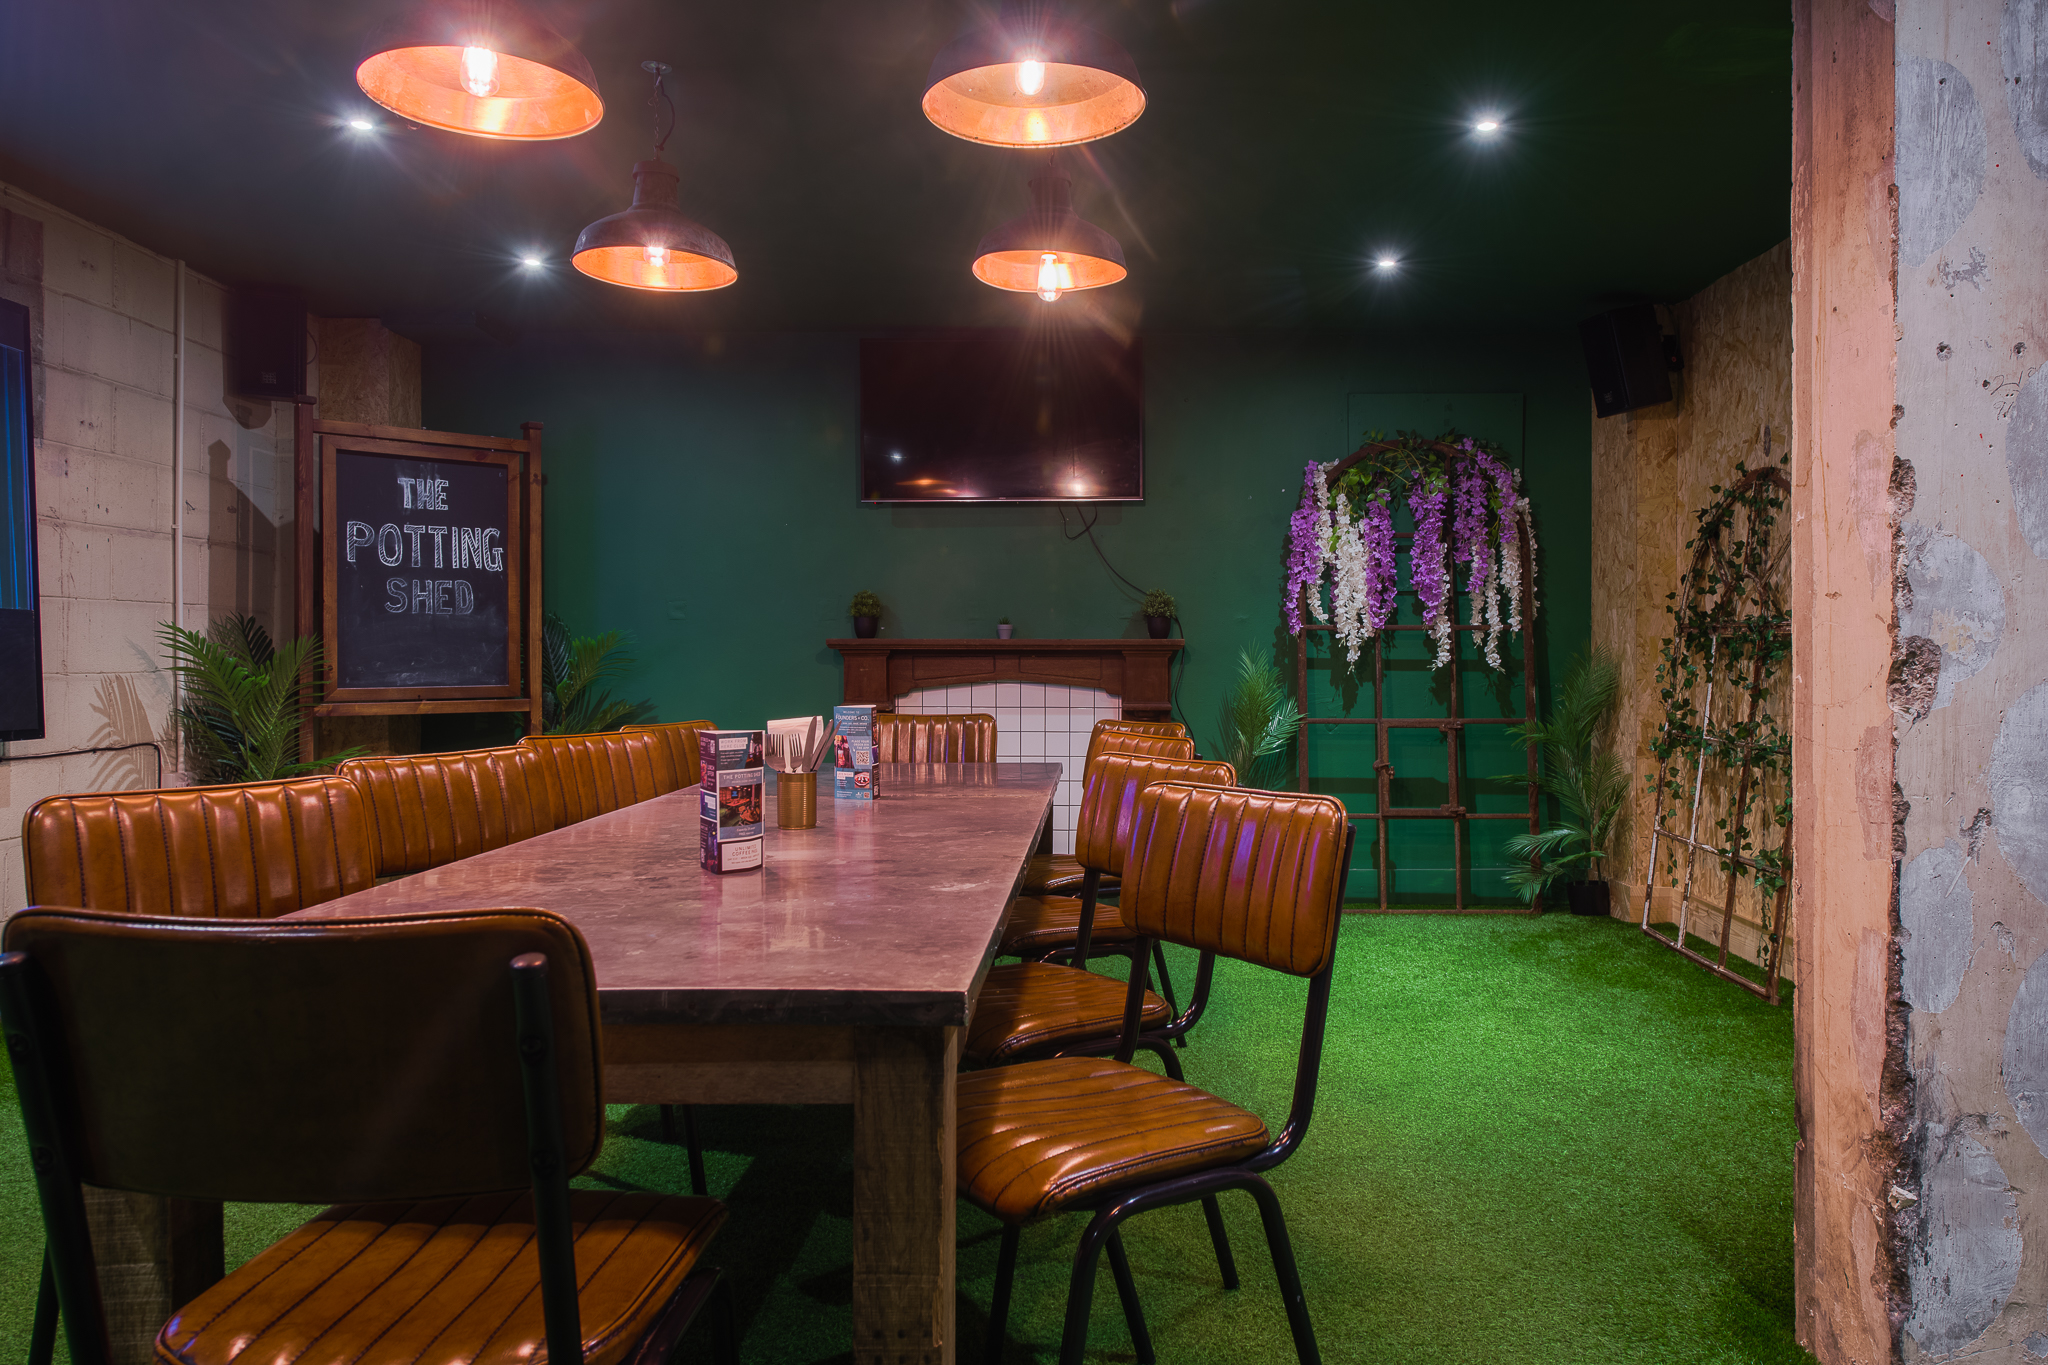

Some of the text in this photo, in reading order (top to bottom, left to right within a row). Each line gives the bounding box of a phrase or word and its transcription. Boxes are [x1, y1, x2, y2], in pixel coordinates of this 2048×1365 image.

[397, 477, 449, 510] THE
[346, 520, 504, 572] POTTING
[384, 577, 475, 615] SHED
